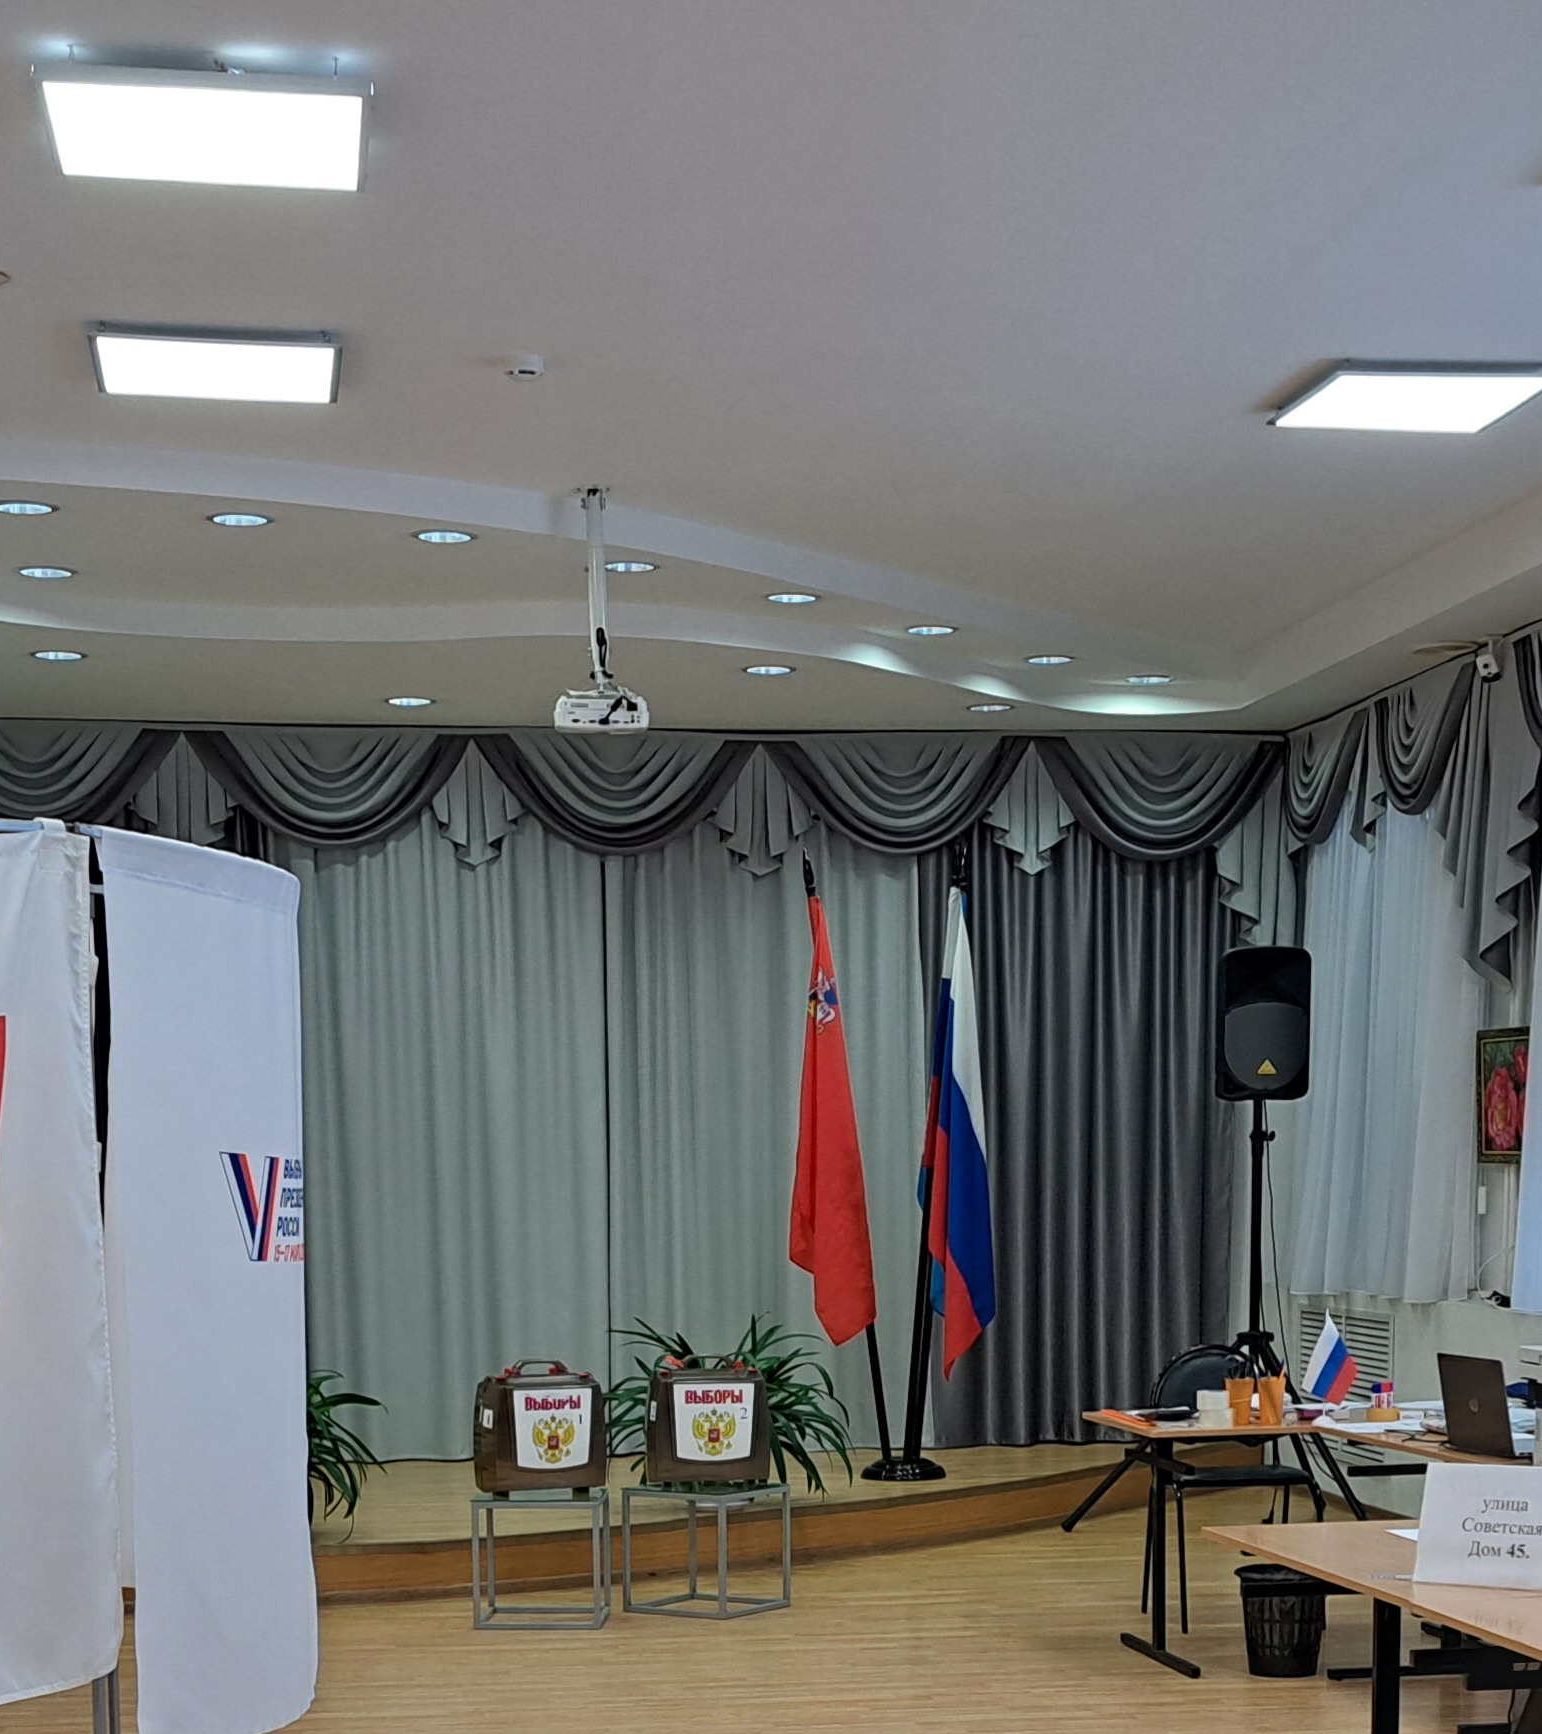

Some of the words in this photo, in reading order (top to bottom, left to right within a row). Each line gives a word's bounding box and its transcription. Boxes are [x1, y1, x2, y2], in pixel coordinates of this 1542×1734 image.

[685, 1389, 743, 1404] ВЫБОРЫ
[740, 1407, 748, 1420] 2
[1481, 1498, 1529, 1514] улица
[1467, 1540, 1501, 1559] Дом
[1506, 1543, 1530, 1560] 45.
